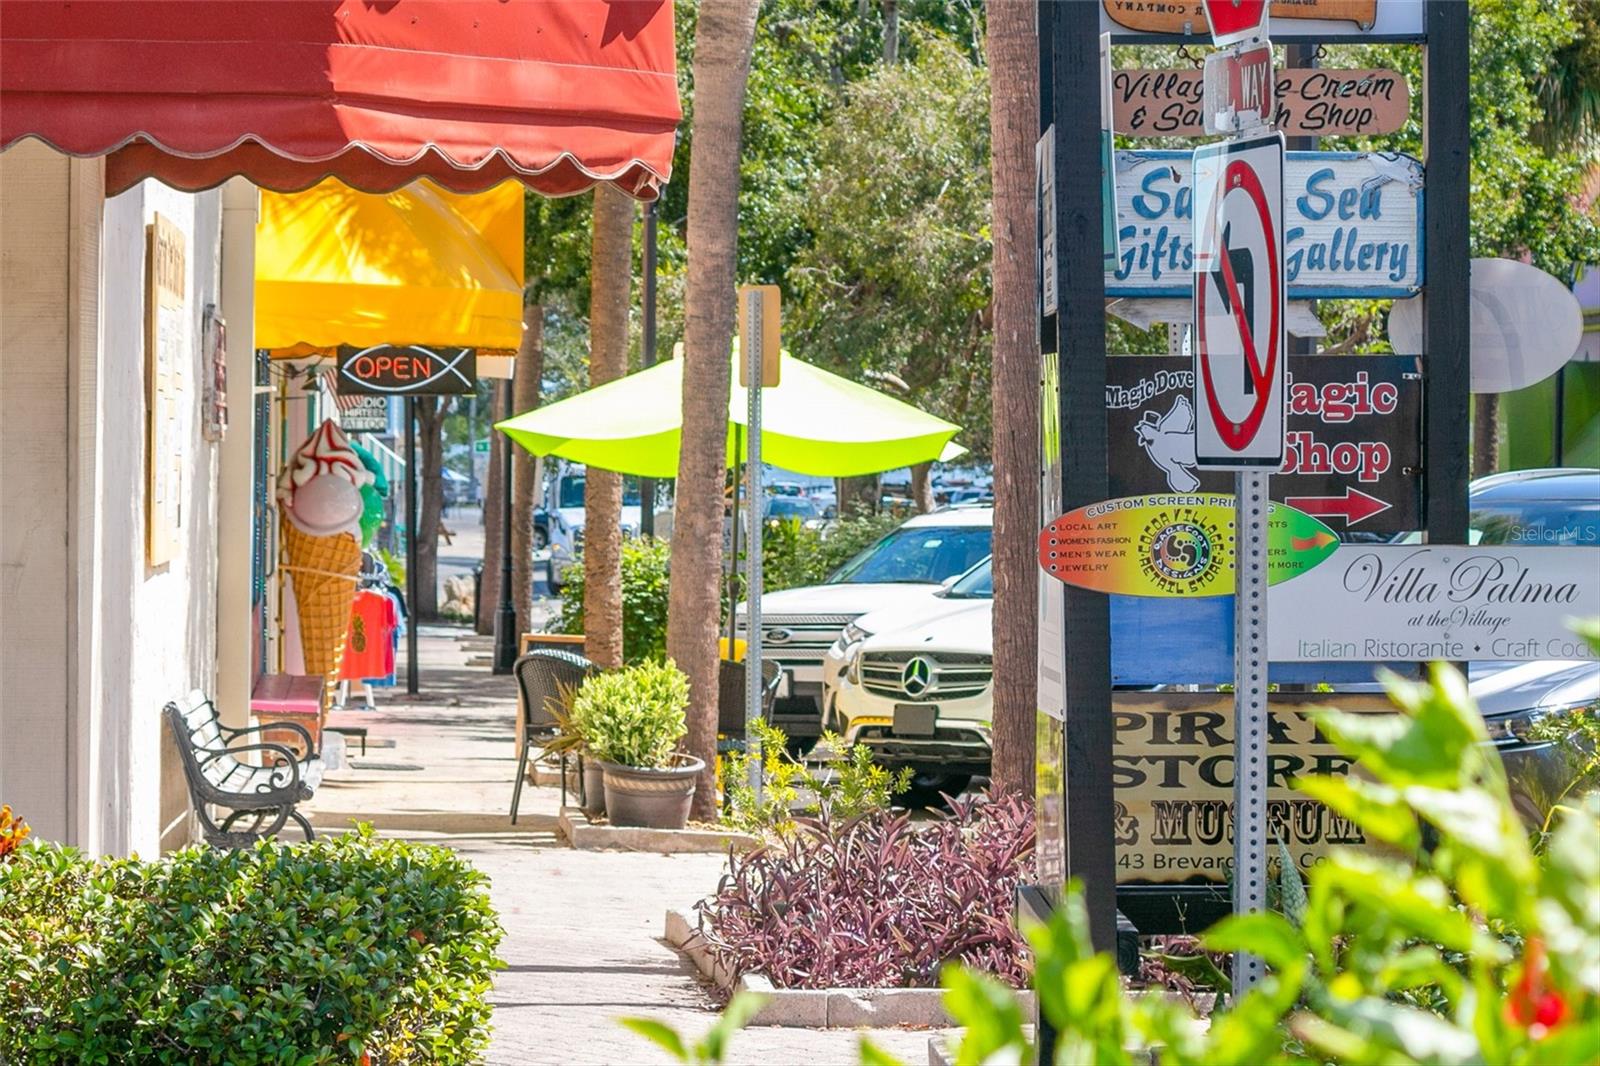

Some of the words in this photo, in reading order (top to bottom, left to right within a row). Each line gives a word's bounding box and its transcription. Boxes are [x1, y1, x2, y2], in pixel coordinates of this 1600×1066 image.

[1114, 73, 1204, 104] Villag
[1240, 61, 1267, 109] WAY
[1130, 106, 1147, 129] &
[1299, 102, 1373, 132] Shop
[1296, 168, 1382, 220] Sea
[355, 356, 431, 379] OPEN
[1105, 377, 1154, 410] Magic
[1287, 371, 1398, 423] agic
[340, 418, 387, 429] TATTOO
[1086, 499, 1145, 518] CUSTOM
[1148, 495, 1205, 507] SCREEN
[1058, 536, 1095, 545] WOMEN'S
[1096, 536, 1132, 544] FASHION
[1059, 523, 1093, 531] LOCAL
[1097, 522, 1118, 530] ART
[1138, 512, 1170, 554] COCOA
[1173, 508, 1225, 552] VILLAGE
[1060, 563, 1109, 572] JEWELRY
[1139, 557, 1184, 594] RETAIL
[1188, 555, 1224, 593] STORE
[1277, 561, 1305, 569] MORE
[1343, 549, 1442, 603] Villa
[1447, 555, 1580, 603] Palma
[1407, 614, 1425, 627] at
[1426, 609, 1450, 627] the
[1449, 603, 1512, 635] Village
[1298, 639, 1357, 658] Italian
[1364, 638, 1464, 658] Ristorante
[1491, 638, 1541, 658] Craft
[1112, 754, 1355, 789] STORE
[1112, 800, 1140, 845] &
